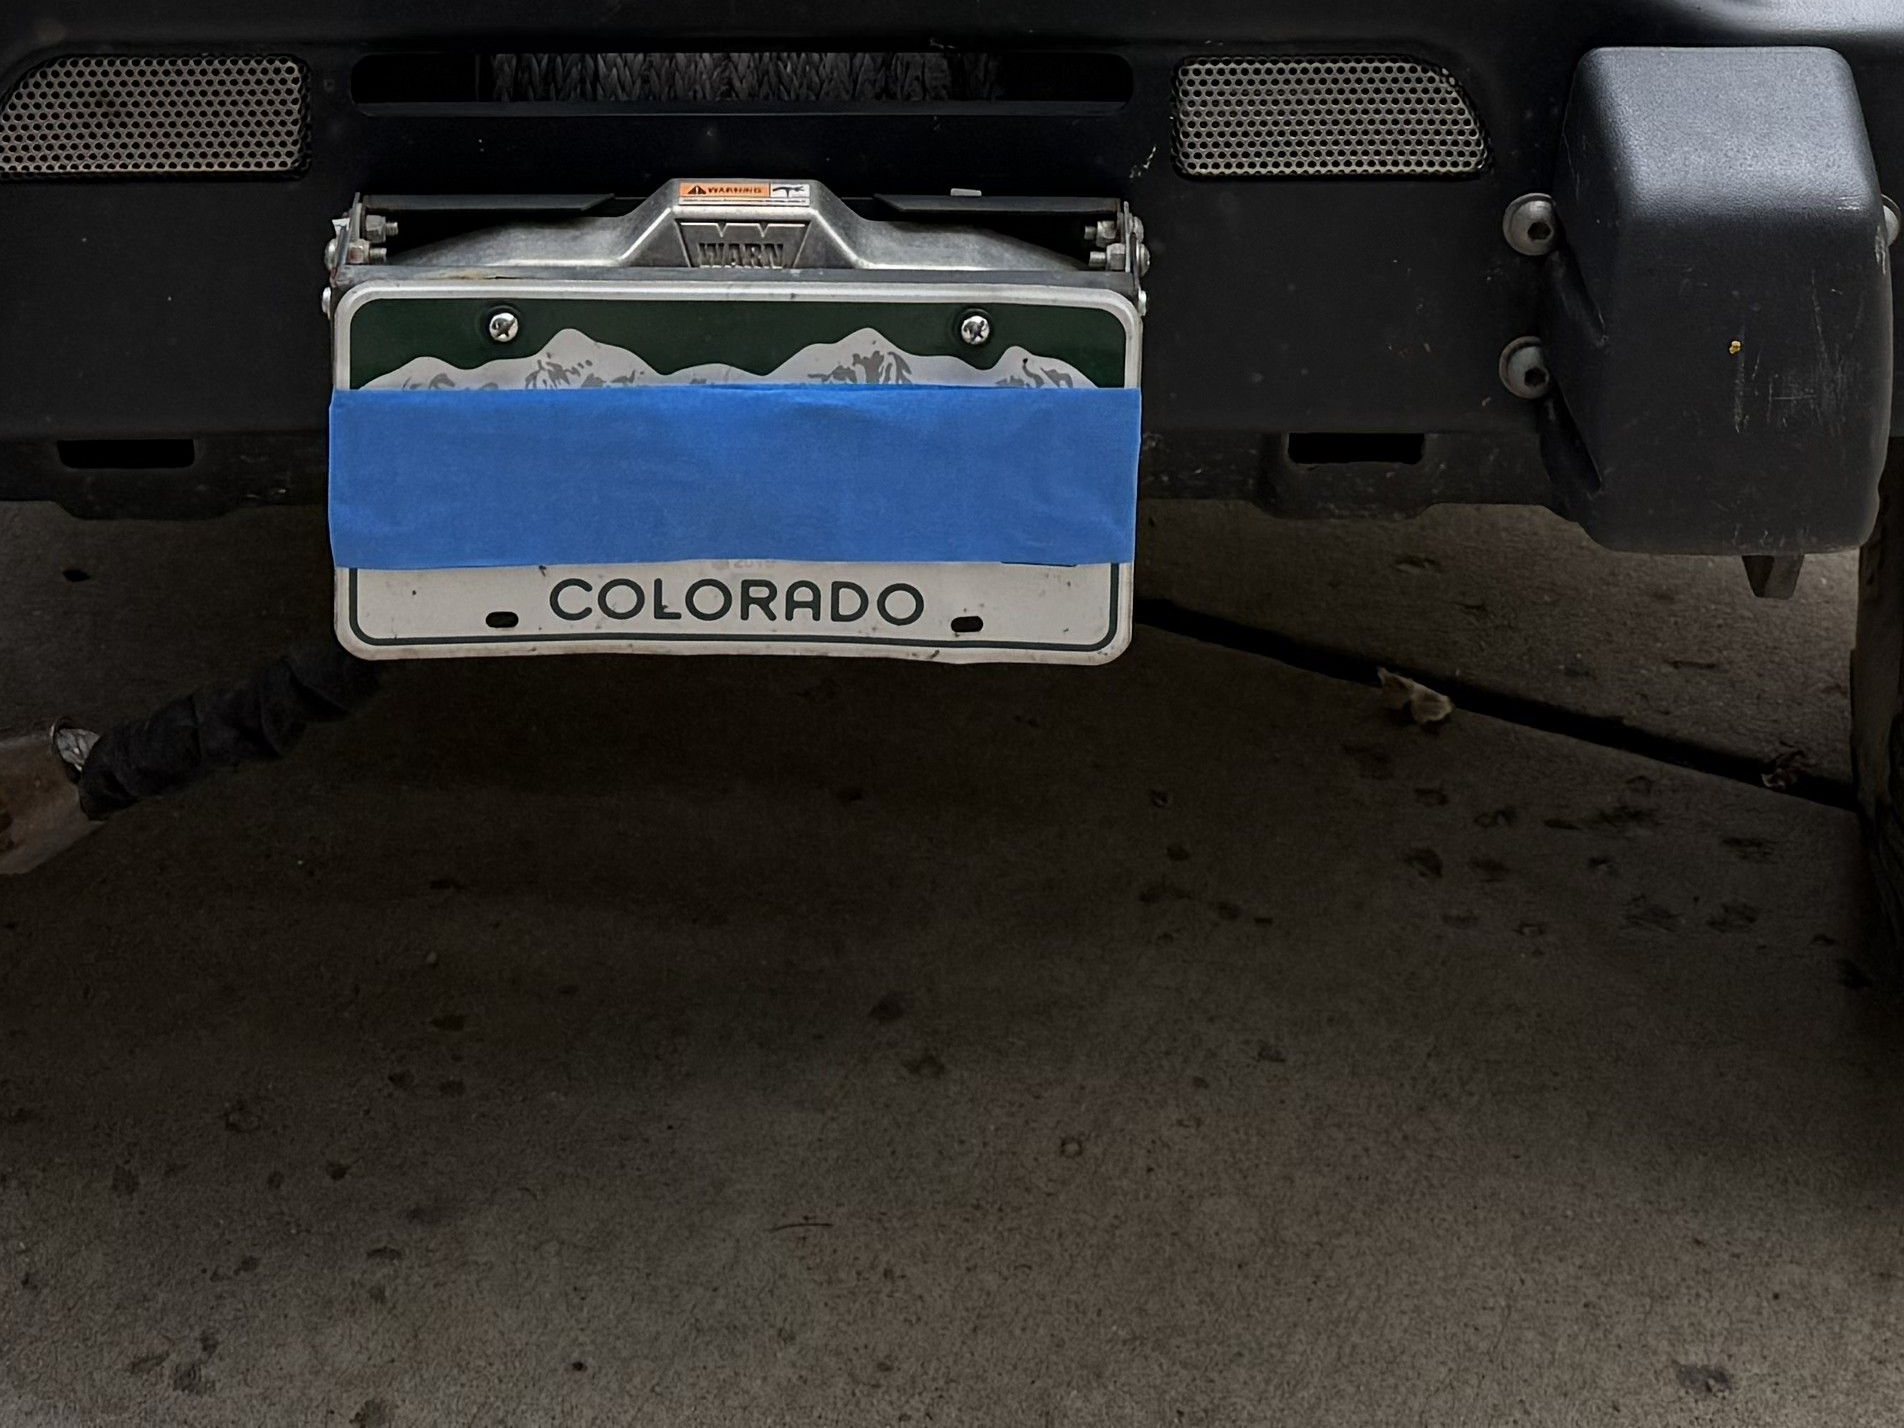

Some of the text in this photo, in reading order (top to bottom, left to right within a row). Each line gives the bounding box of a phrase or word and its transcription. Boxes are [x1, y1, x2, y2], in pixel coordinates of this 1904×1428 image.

[707, 186, 762, 194] WARNING
[698, 242, 784, 269] WARN
[549, 576, 925, 626] COLORADO
